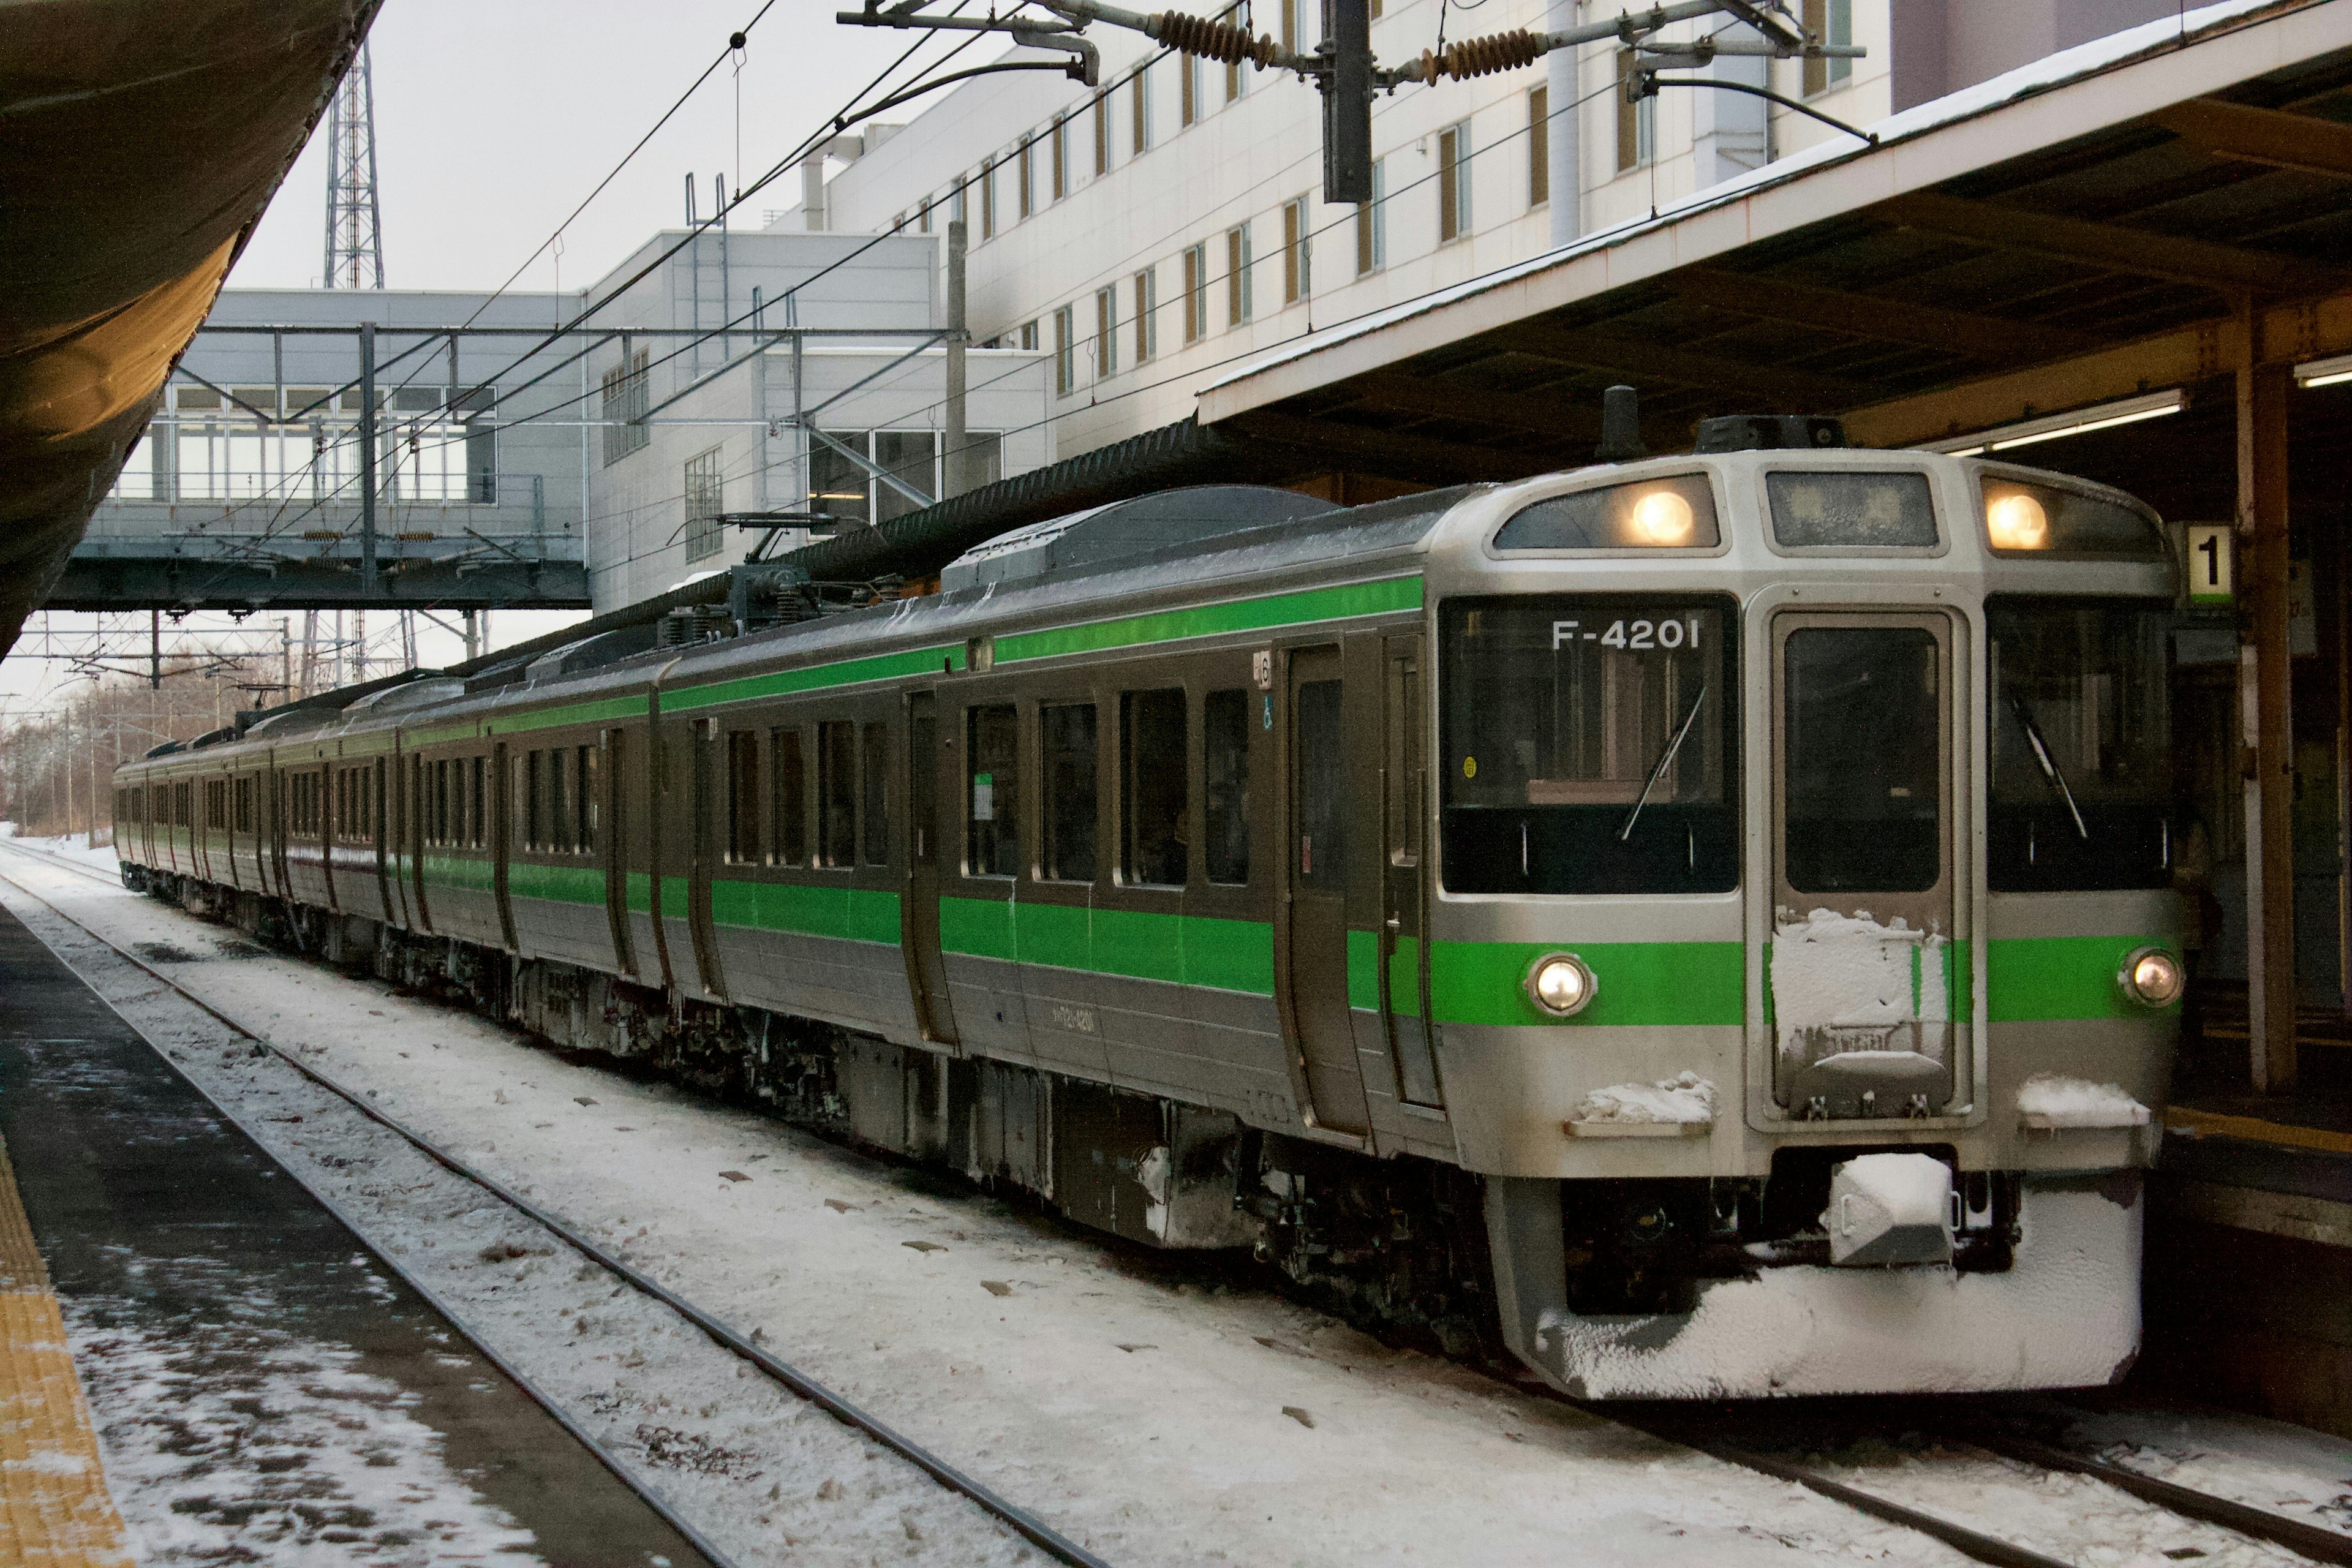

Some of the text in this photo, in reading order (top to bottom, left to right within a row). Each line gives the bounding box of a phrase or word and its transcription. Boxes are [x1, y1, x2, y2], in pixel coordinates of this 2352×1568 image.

[2199, 535, 2218, 586] 1
[1553, 619, 1699, 650] F-4201
[1262, 657, 1268, 682] 6
